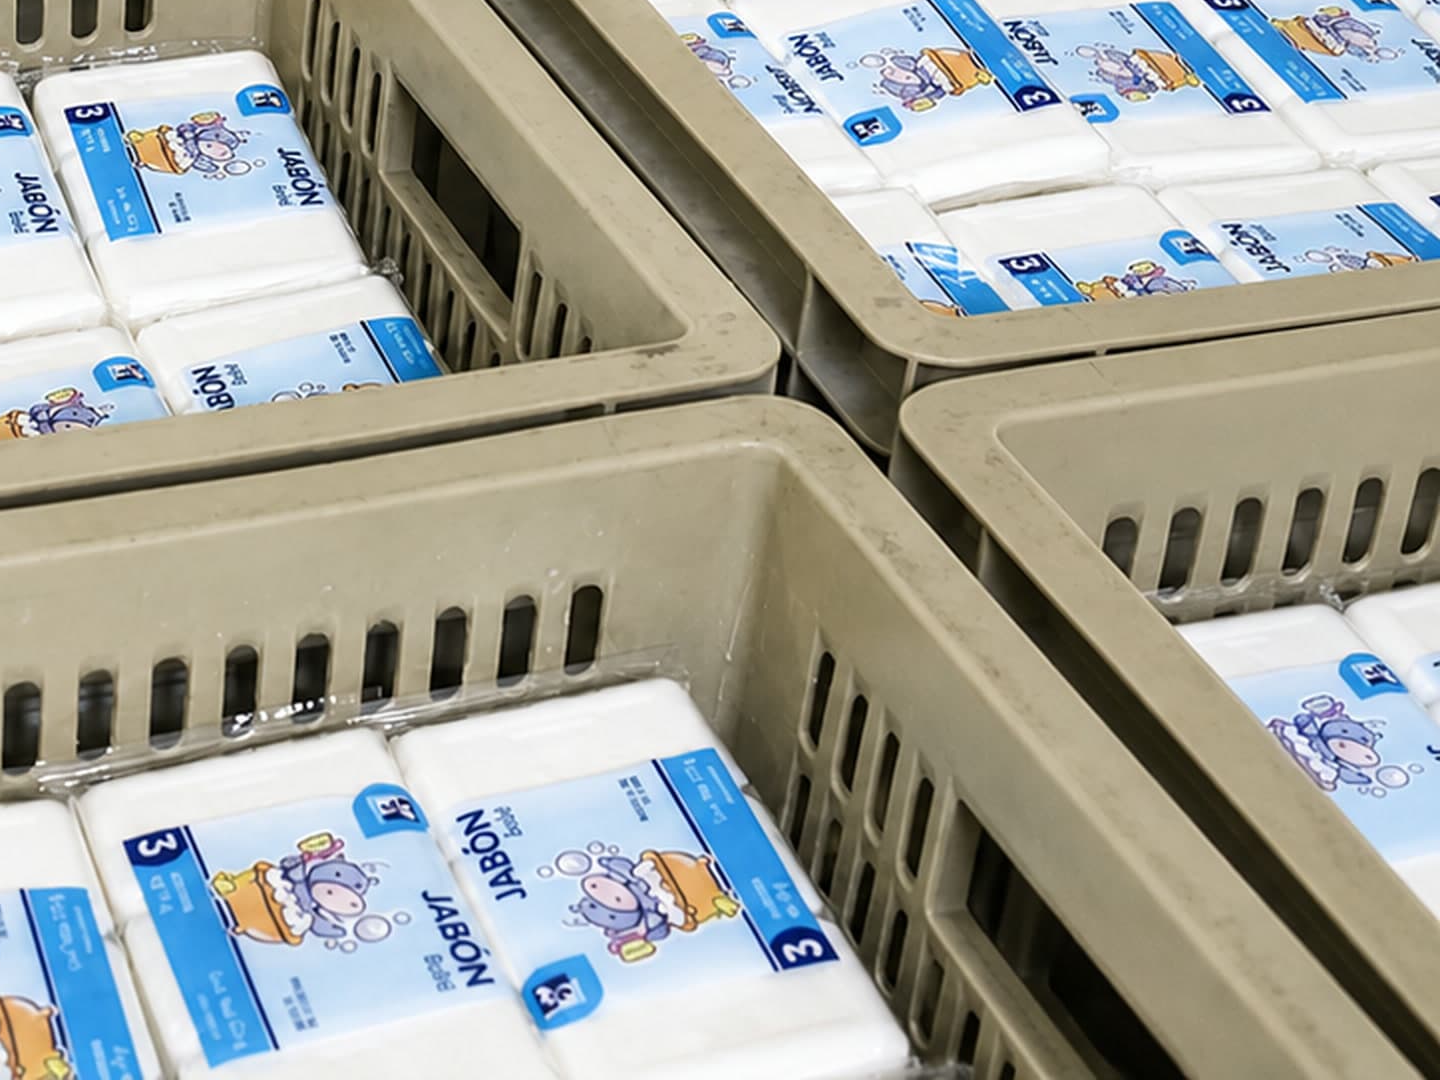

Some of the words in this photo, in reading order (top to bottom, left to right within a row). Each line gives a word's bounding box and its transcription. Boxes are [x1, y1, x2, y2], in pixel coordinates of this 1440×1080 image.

[787, 33, 844, 83] JABÓN
[74, 105, 104, 119] 3
[1022, 90, 1052, 106] 3
[1231, 96, 1262, 111] 3
[277, 147, 325, 206] JABÓN
[14, 173, 60, 233] JABÓN
[138, 833, 177, 856] 3
[456, 808, 527, 900] JABÓN
[422, 889, 495, 989] JABÓN
[782, 937, 823, 963] 3
